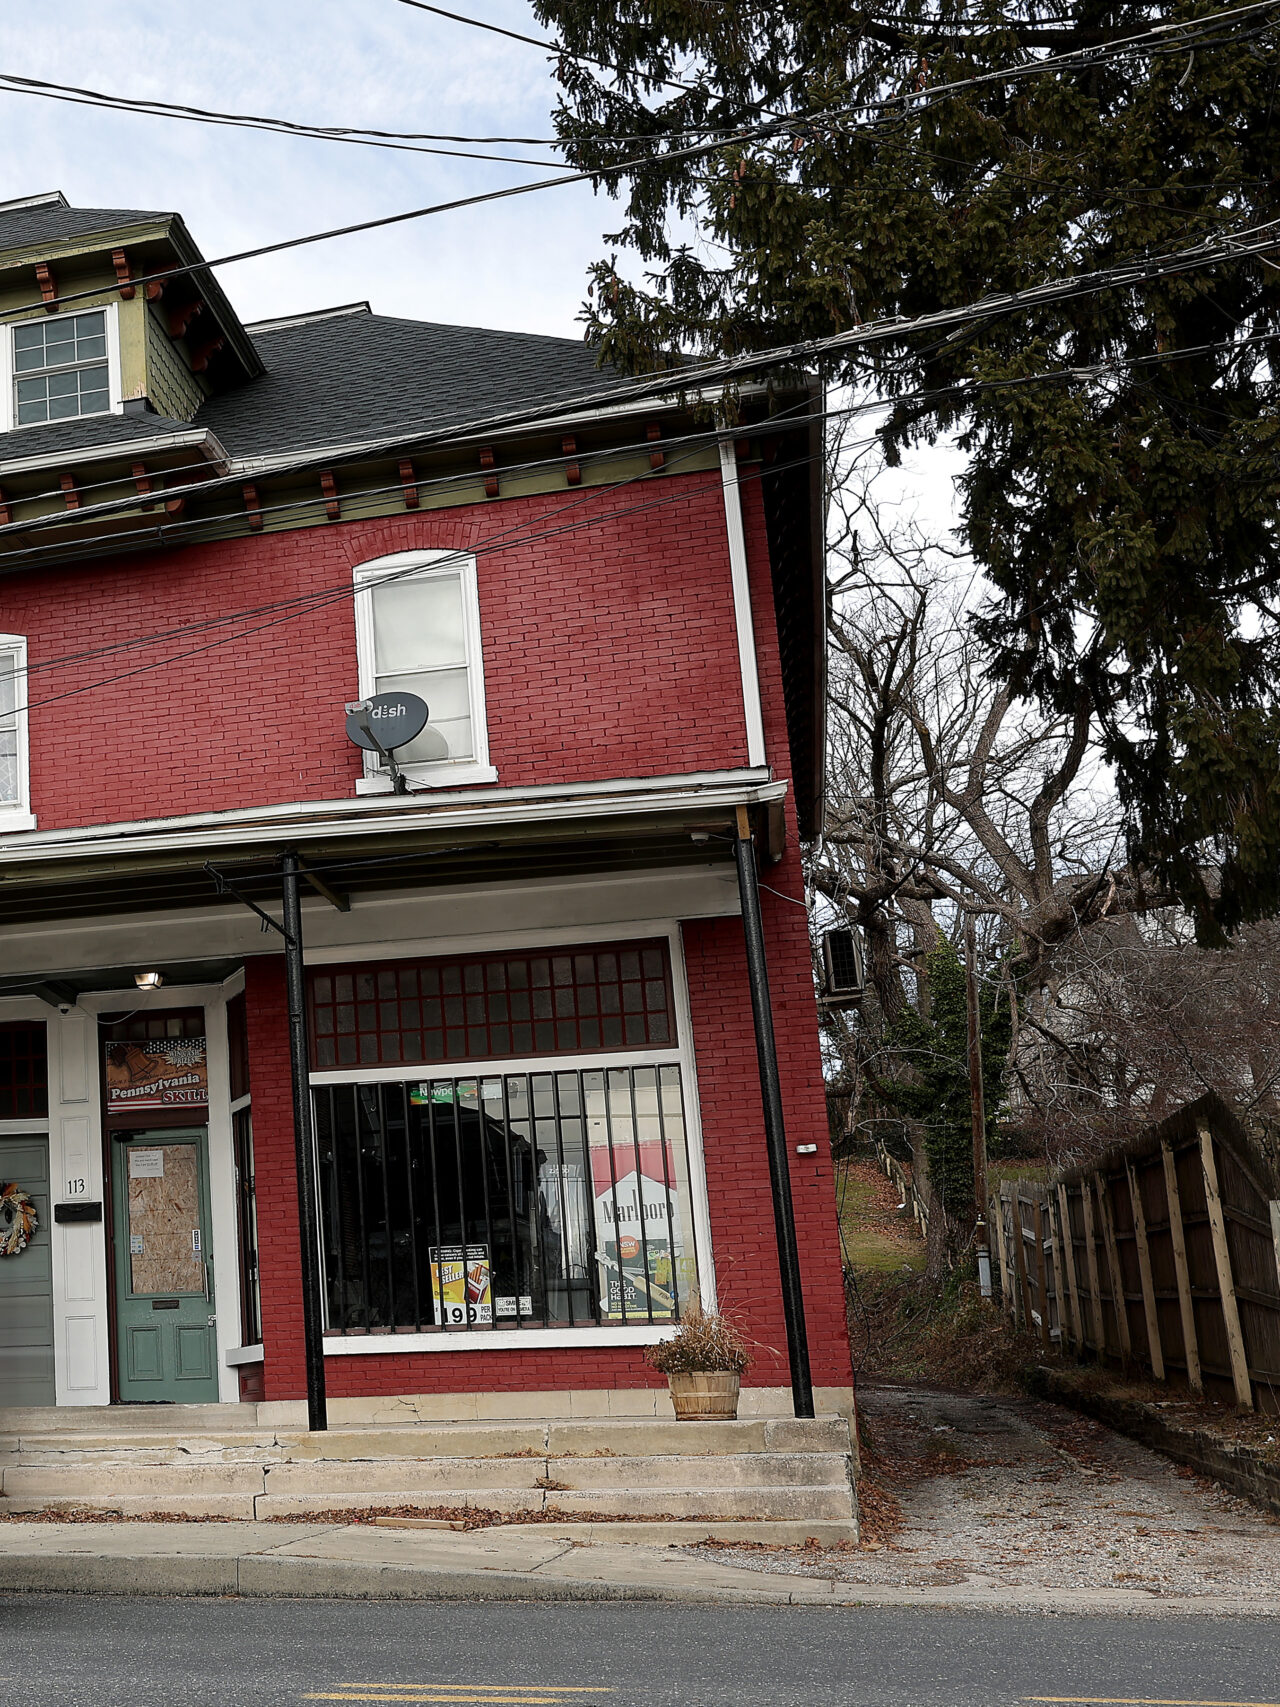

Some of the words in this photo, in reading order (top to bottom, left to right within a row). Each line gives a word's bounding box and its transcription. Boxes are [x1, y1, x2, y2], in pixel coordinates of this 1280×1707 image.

[371, 703, 406, 718] dish
[173, 1056, 195, 1064] PRIZES
[111, 1073, 200, 1099] Pennsylvania
[419, 1085, 462, 1097] Nwpot
[162, 1088, 209, 1104] SKILL
[67, 1178, 86, 1195] 113
[441, 1270, 464, 1284] SELLER
[609, 1280, 627, 1288] THE
[480, 1305, 491, 1314] PER
[480, 1313, 492, 1322] PACK
